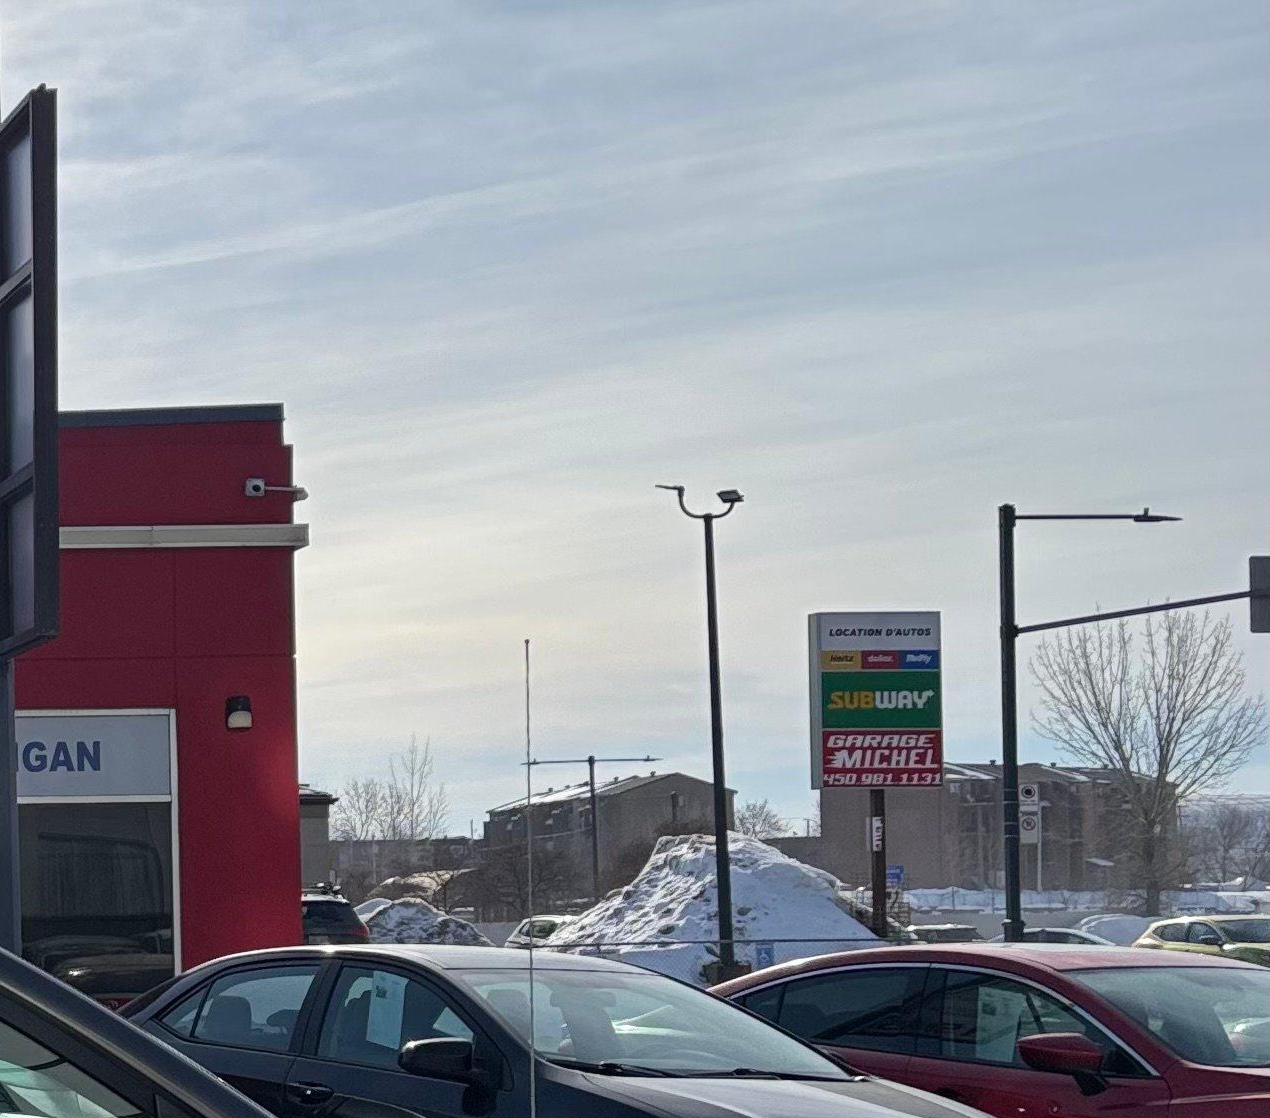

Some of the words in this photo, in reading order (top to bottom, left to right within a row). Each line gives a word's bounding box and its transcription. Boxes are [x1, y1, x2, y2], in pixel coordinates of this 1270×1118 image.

[828, 628, 882, 637] LOCATION
[885, 628, 932, 637] D'AUTOS
[827, 689, 935, 710] SUBWAY
[826, 734, 936, 748] GARAGE
[837, 749, 939, 768] MICHEL
